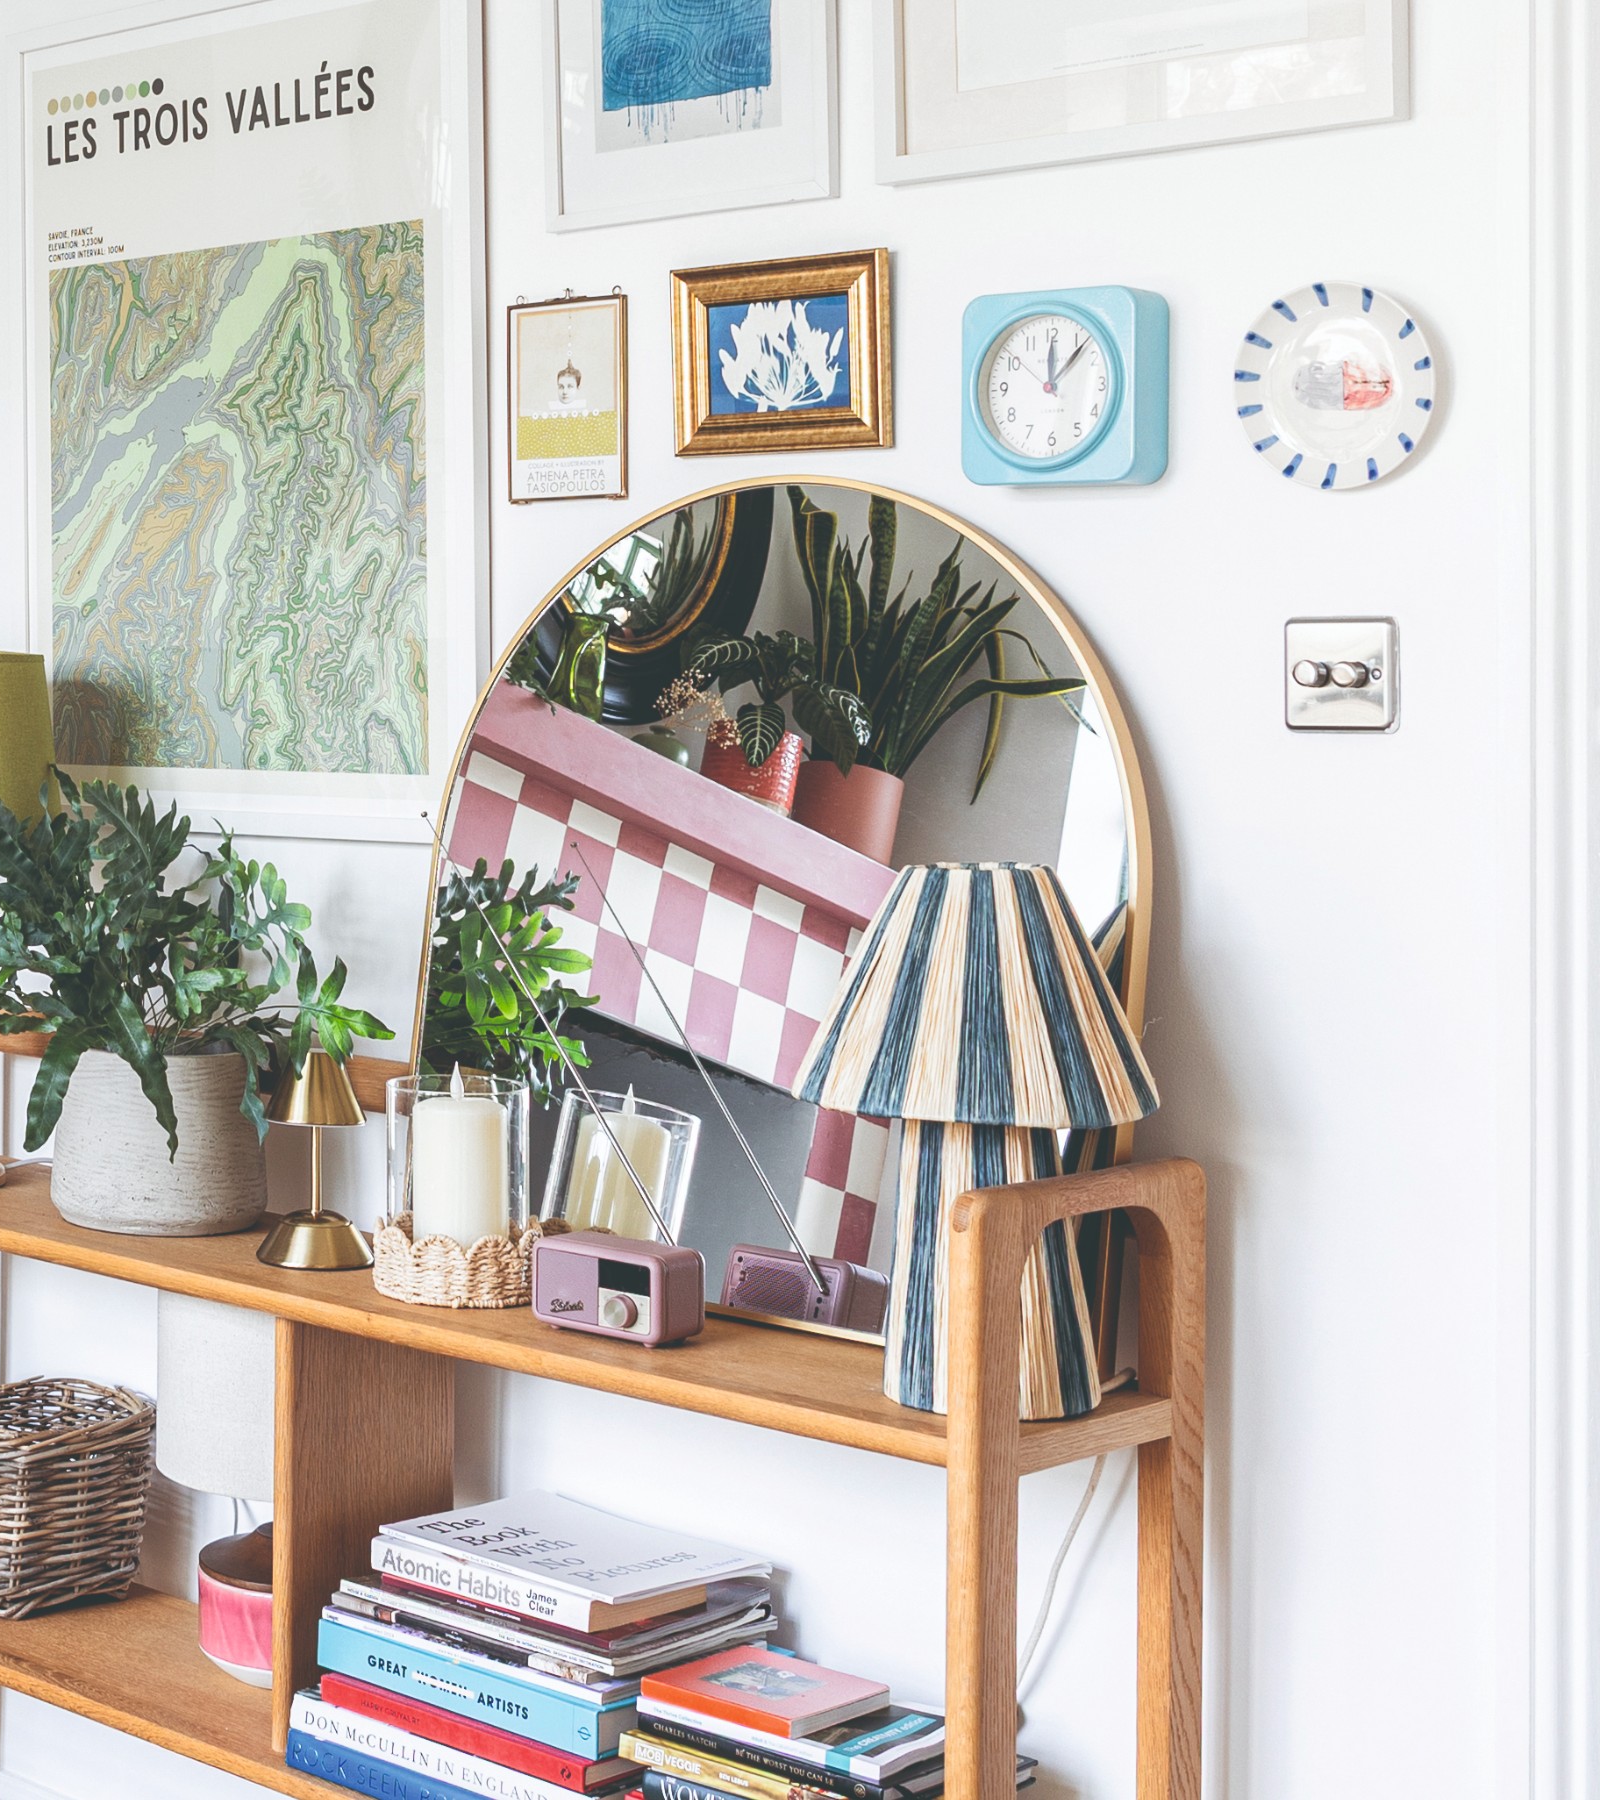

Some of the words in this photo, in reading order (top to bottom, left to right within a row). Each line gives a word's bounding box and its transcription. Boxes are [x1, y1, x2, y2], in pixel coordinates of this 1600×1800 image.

[47, 117, 97, 166] LES
[113, 97, 208, 153] TROIS
[225, 61, 375, 134] VALLÉES
[70, 226, 93, 238] FRANCE
[48, 251, 76, 262] CONTOUR
[1026, 335, 1035, 351] 11
[1046, 328, 1059, 343] 12
[1008, 356, 1021, 372] 10
[1090, 351, 1099, 366] 2
[1000, 382, 1009, 397] 9
[1098, 376, 1106, 391] 3
[1007, 407, 1016, 422] 8
[1090, 403, 1098, 418] 4
[1025, 425, 1034, 439] 7
[1073, 422, 1082, 438] 5
[1047, 431, 1056, 446] 6
[527, 470, 569, 482] ATHENA
[573, 469, 606, 480] PETRA
[527, 480, 606, 493] TASIOPOULOS
[417, 1518, 486, 1534] The
[452, 1526, 540, 1546] Book
[489, 1539, 578, 1557] With
[529, 1557, 585, 1570] No
[568, 1552, 697, 1581] Pictures
[382, 1548, 451, 1586] Atomic
[458, 1569, 520, 1607] Habits
[526, 1589, 558, 1606] James
[529, 1600, 555, 1616] Clear
[367, 1654, 408, 1678] GREAT
[477, 1692, 529, 1720] ARTISTS
[304, 1711, 341, 1735] DON
[346, 1726, 430, 1768] McCULLIN
[437, 1758, 455, 1776] IN
[857, 1728, 903, 1746] CREATIVITY
[637, 1745, 662, 1763] MOB
[664, 1754, 702, 1775] VEGGIE
[653, 1722, 685, 1739] CHARLES
[687, 1733, 717, 1750] SAATCHI
[746, 1750, 761, 1763] THE
[763, 1757, 788, 1771] WORST
[789, 1766, 805, 1777] YOU
[806, 1772, 824, 1783] CAN
[292, 1743, 347, 1780] ROCK
[357, 1764, 408, 1800] SEEN
[666, 1776, 677, 1785] THE
